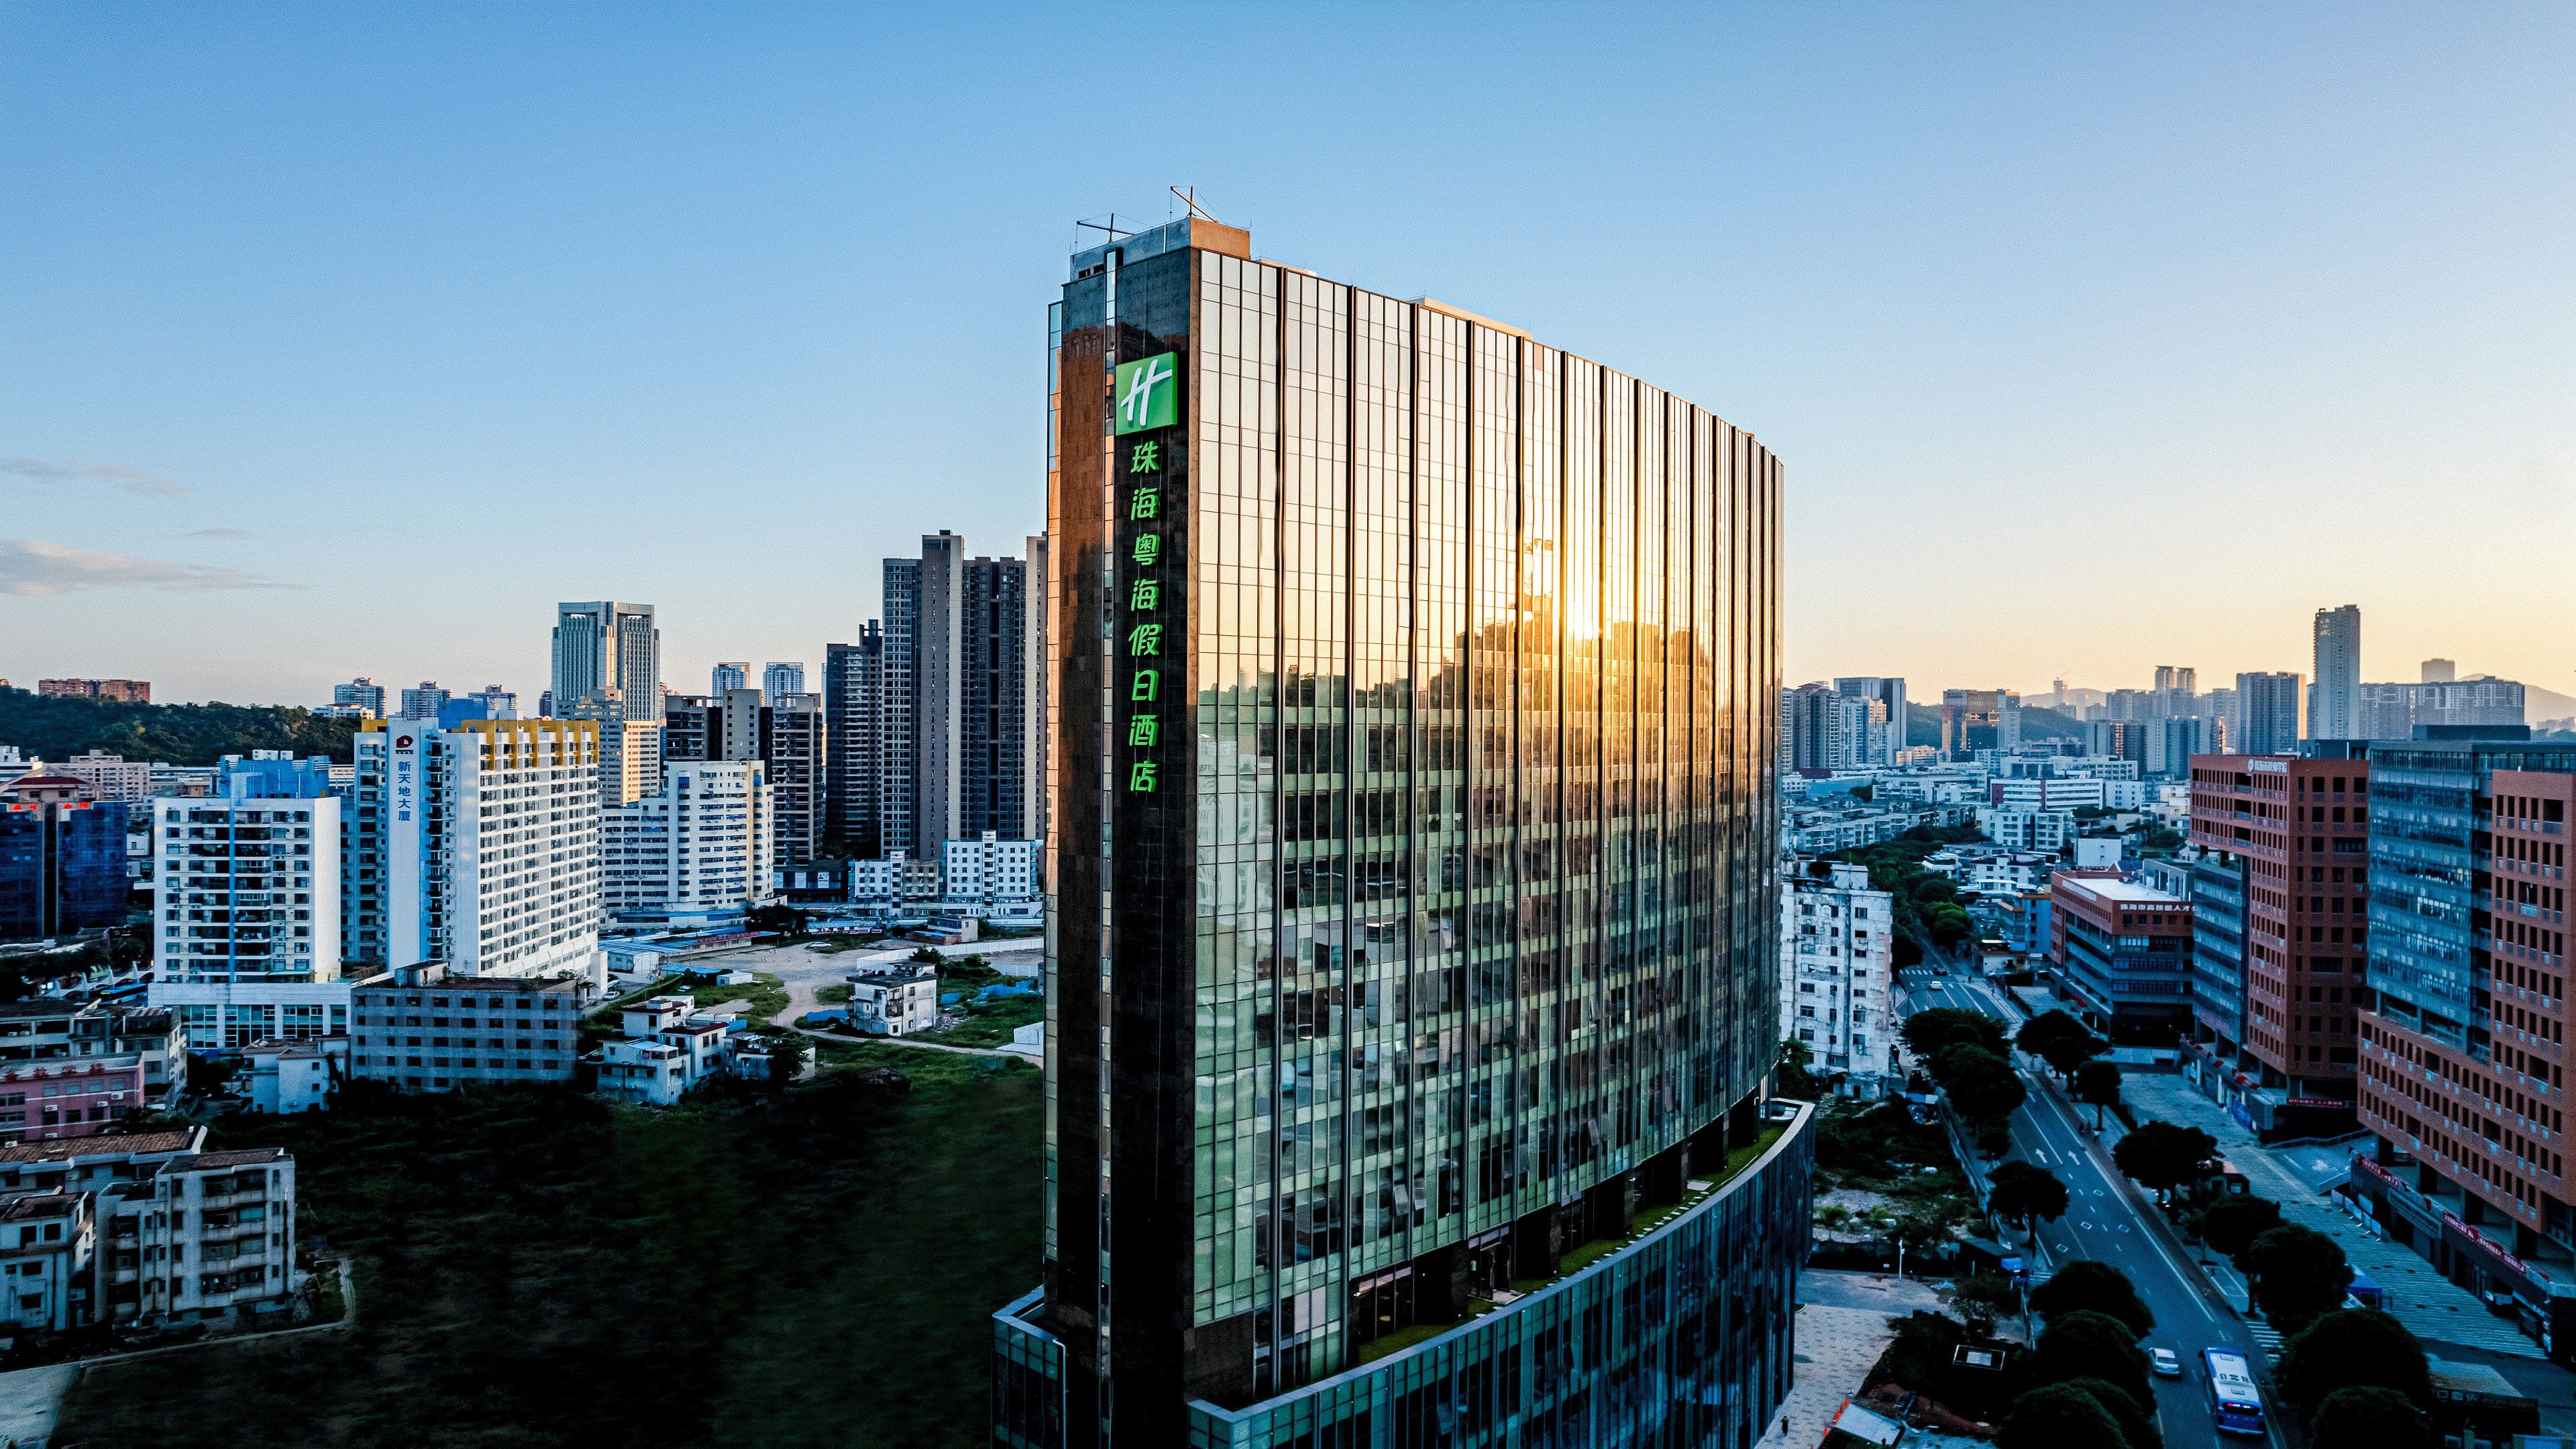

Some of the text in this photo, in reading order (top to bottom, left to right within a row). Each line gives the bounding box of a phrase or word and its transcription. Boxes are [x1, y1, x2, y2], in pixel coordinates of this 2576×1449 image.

[1128, 440, 1160, 792] 珠海粤海假日酒店
[398, 761, 411, 821] 新天地大厦
